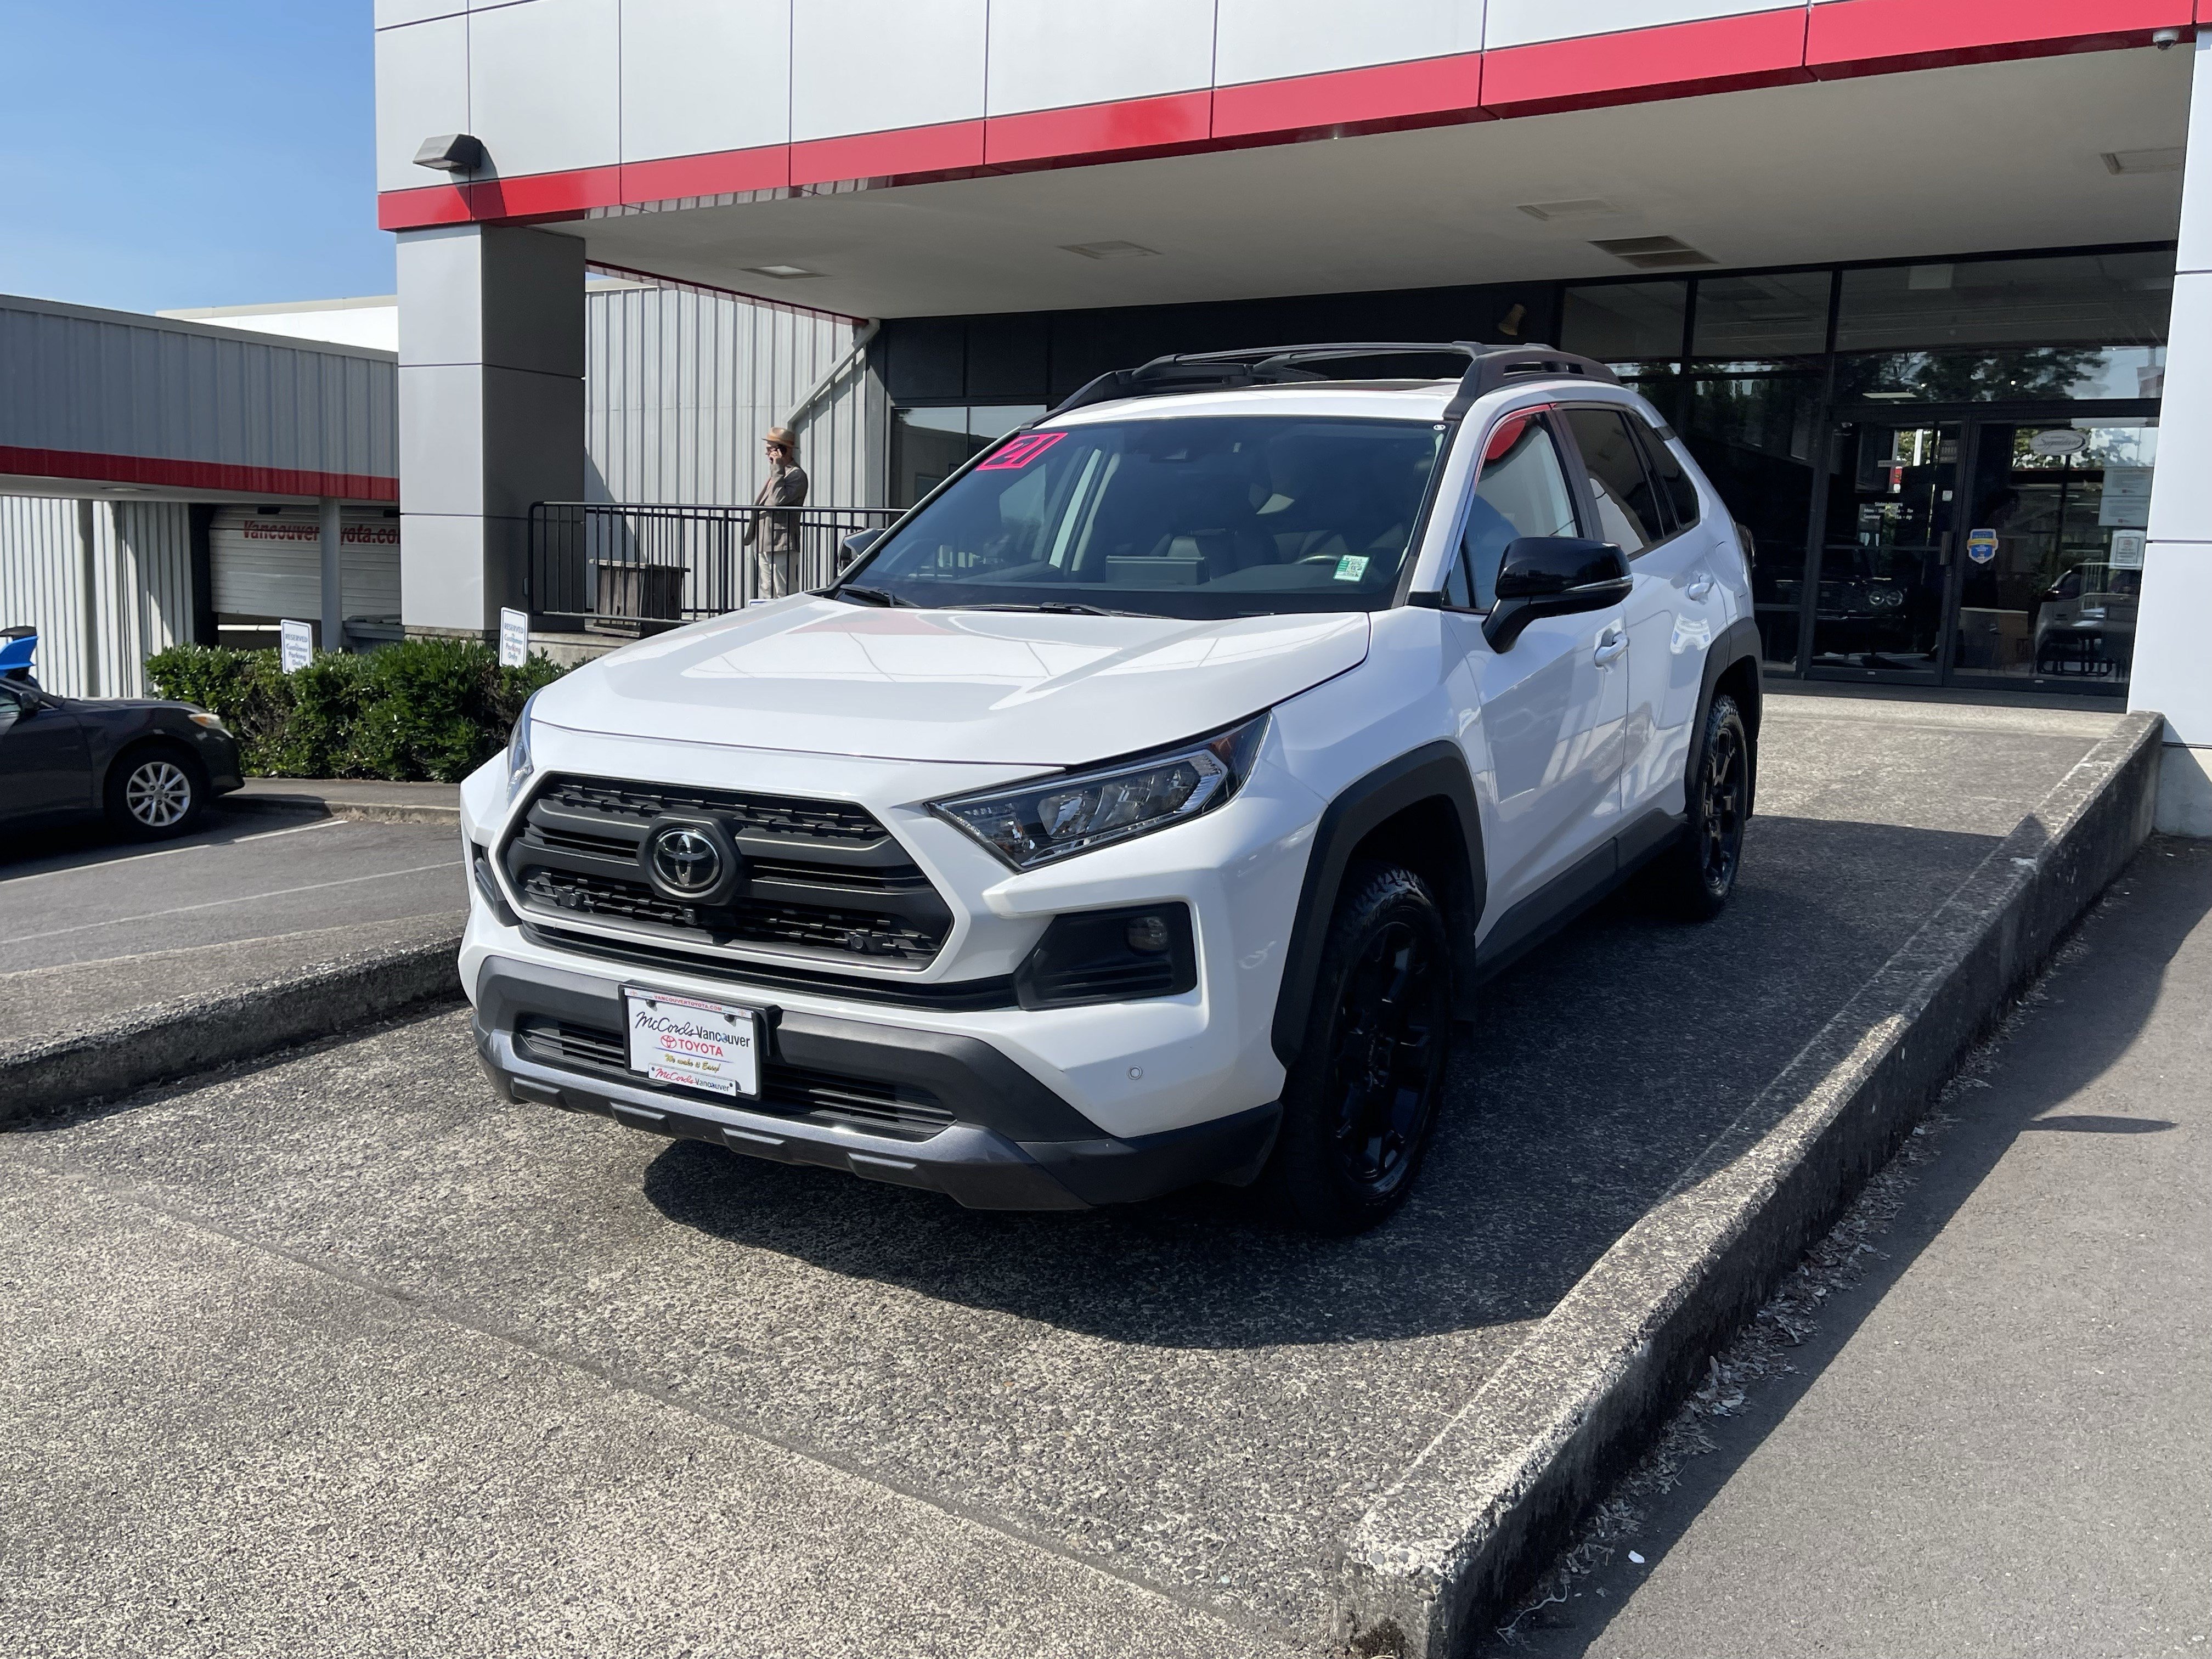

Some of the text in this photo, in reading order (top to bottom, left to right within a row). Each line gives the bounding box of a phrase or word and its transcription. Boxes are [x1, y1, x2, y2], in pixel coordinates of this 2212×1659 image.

[504, 623, 524, 634] RESERVED
[285, 633, 308, 642] RESERVED
[286, 644, 307, 652] Customer
[506, 643, 521, 654] Parking
[288, 651, 306, 662] Parking
[508, 652, 518, 662] Only
[654, 995, 723, 1011] VANCOUVERTOYOTA.COM
[678, 1039, 724, 1057] TOYOTA
